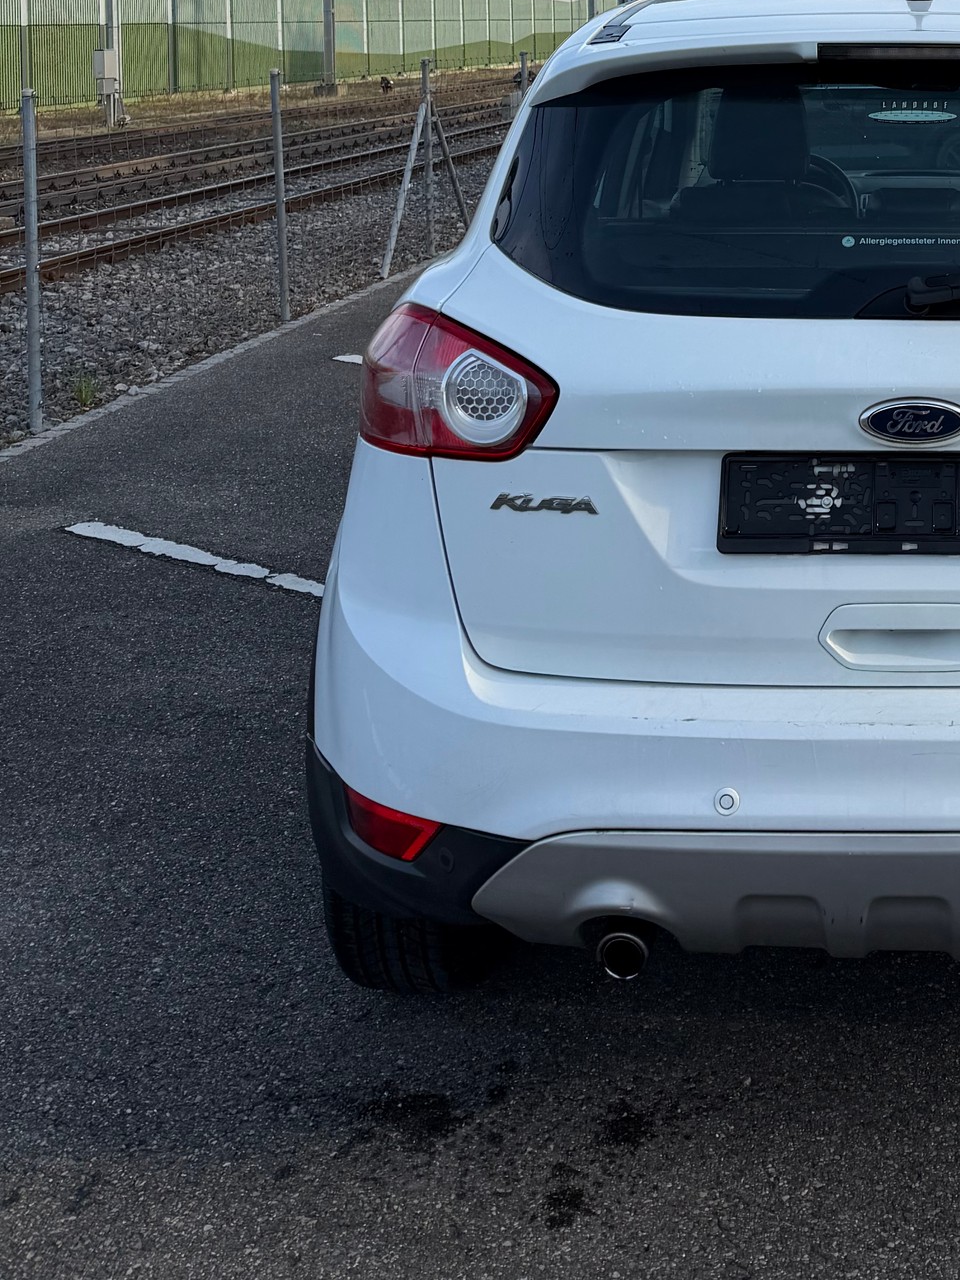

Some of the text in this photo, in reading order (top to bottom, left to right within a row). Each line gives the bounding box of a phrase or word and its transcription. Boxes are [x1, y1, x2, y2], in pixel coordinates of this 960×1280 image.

[882, 101, 948, 109] LANDHOF
[859, 237, 936, 246] Allergiegetesteter
[886, 408, 945, 433] Ford
